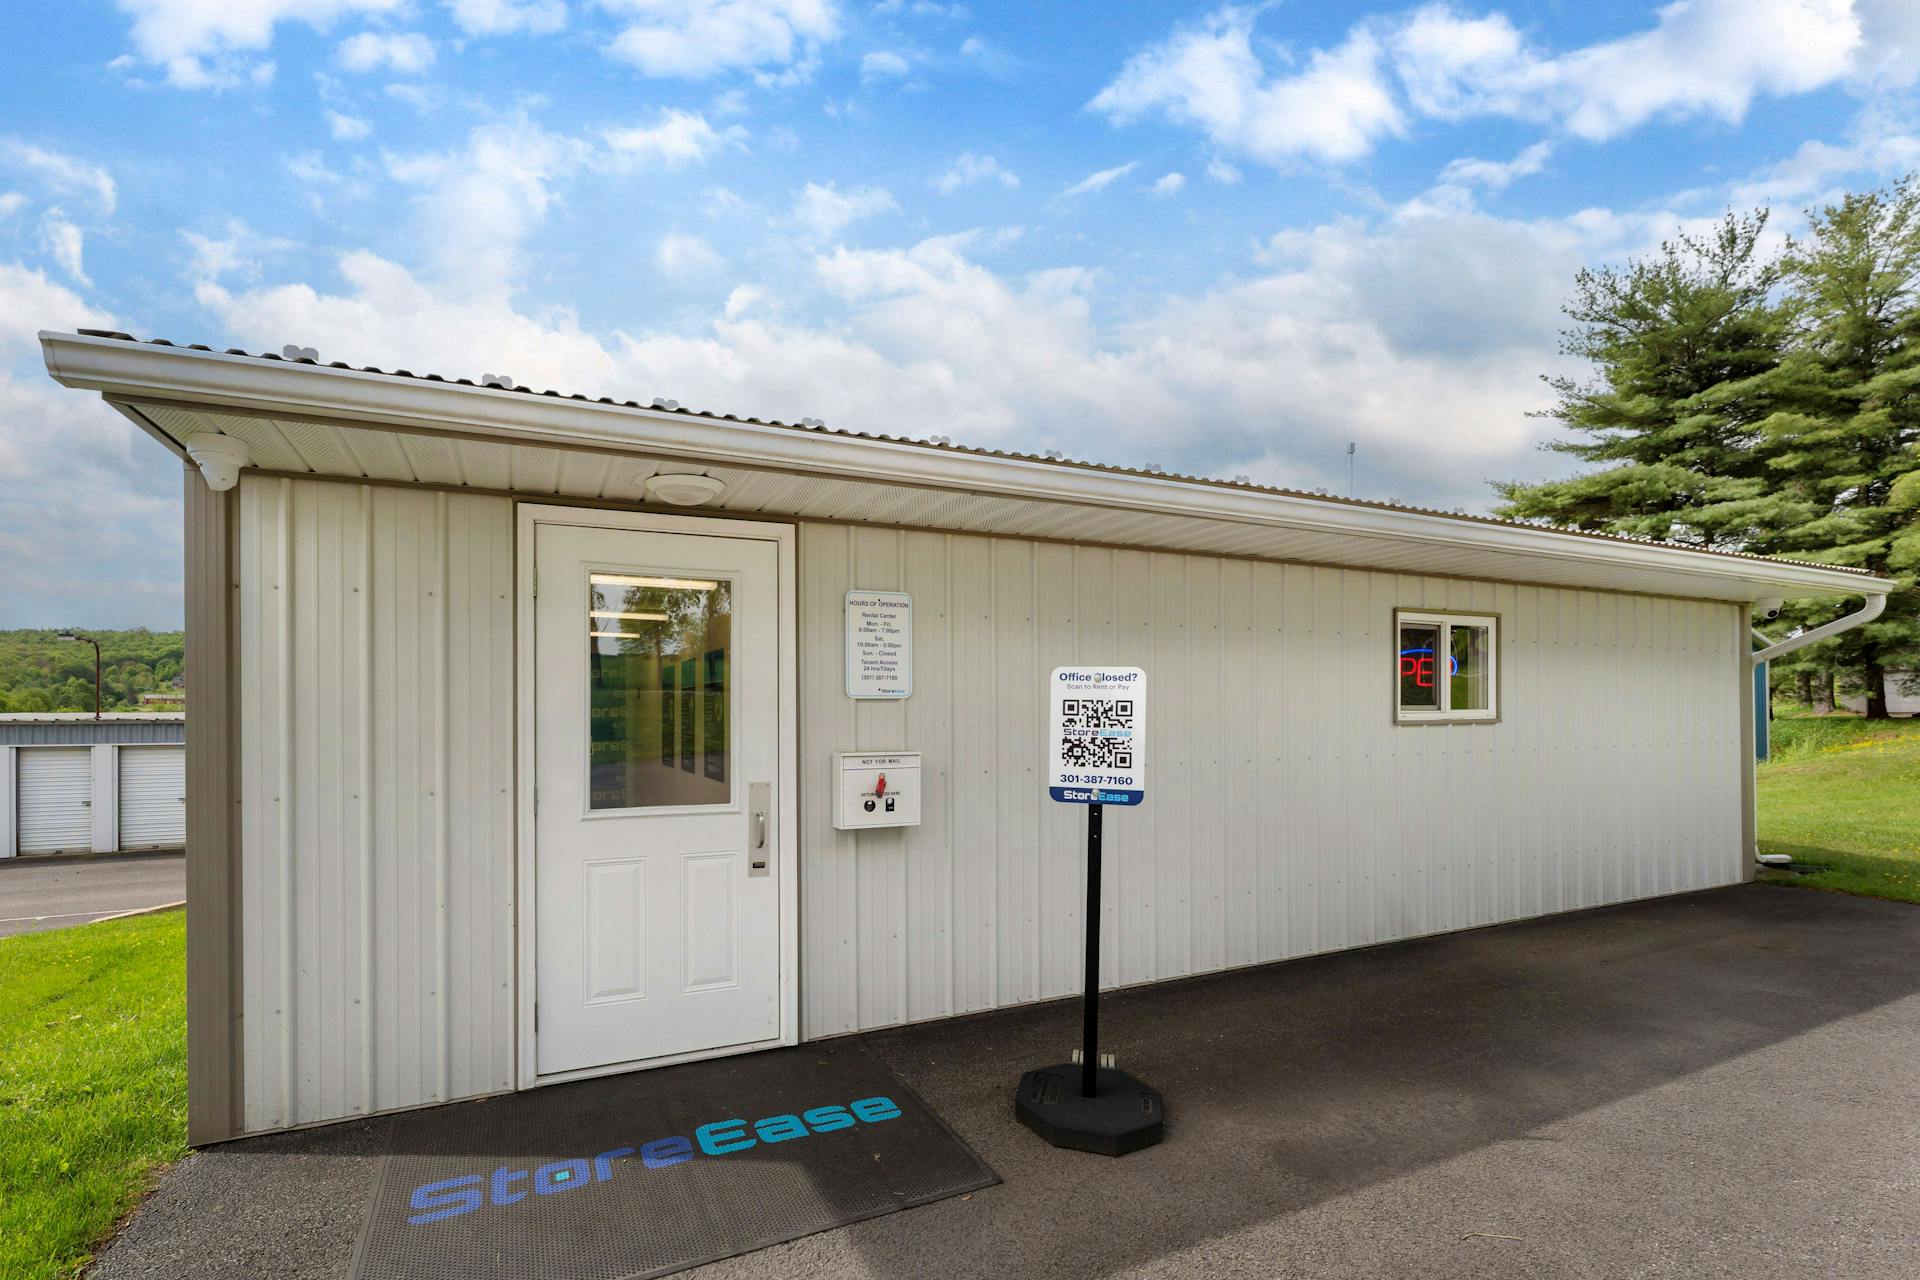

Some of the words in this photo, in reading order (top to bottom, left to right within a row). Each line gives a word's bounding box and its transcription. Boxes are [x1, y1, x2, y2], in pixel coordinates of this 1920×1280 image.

[1060, 672, 1092, 681] Office
[1063, 728, 1132, 737] StoreEase
[1060, 774, 1133, 785] 301-387-7160
[408, 1096, 902, 1225] StoreEase
